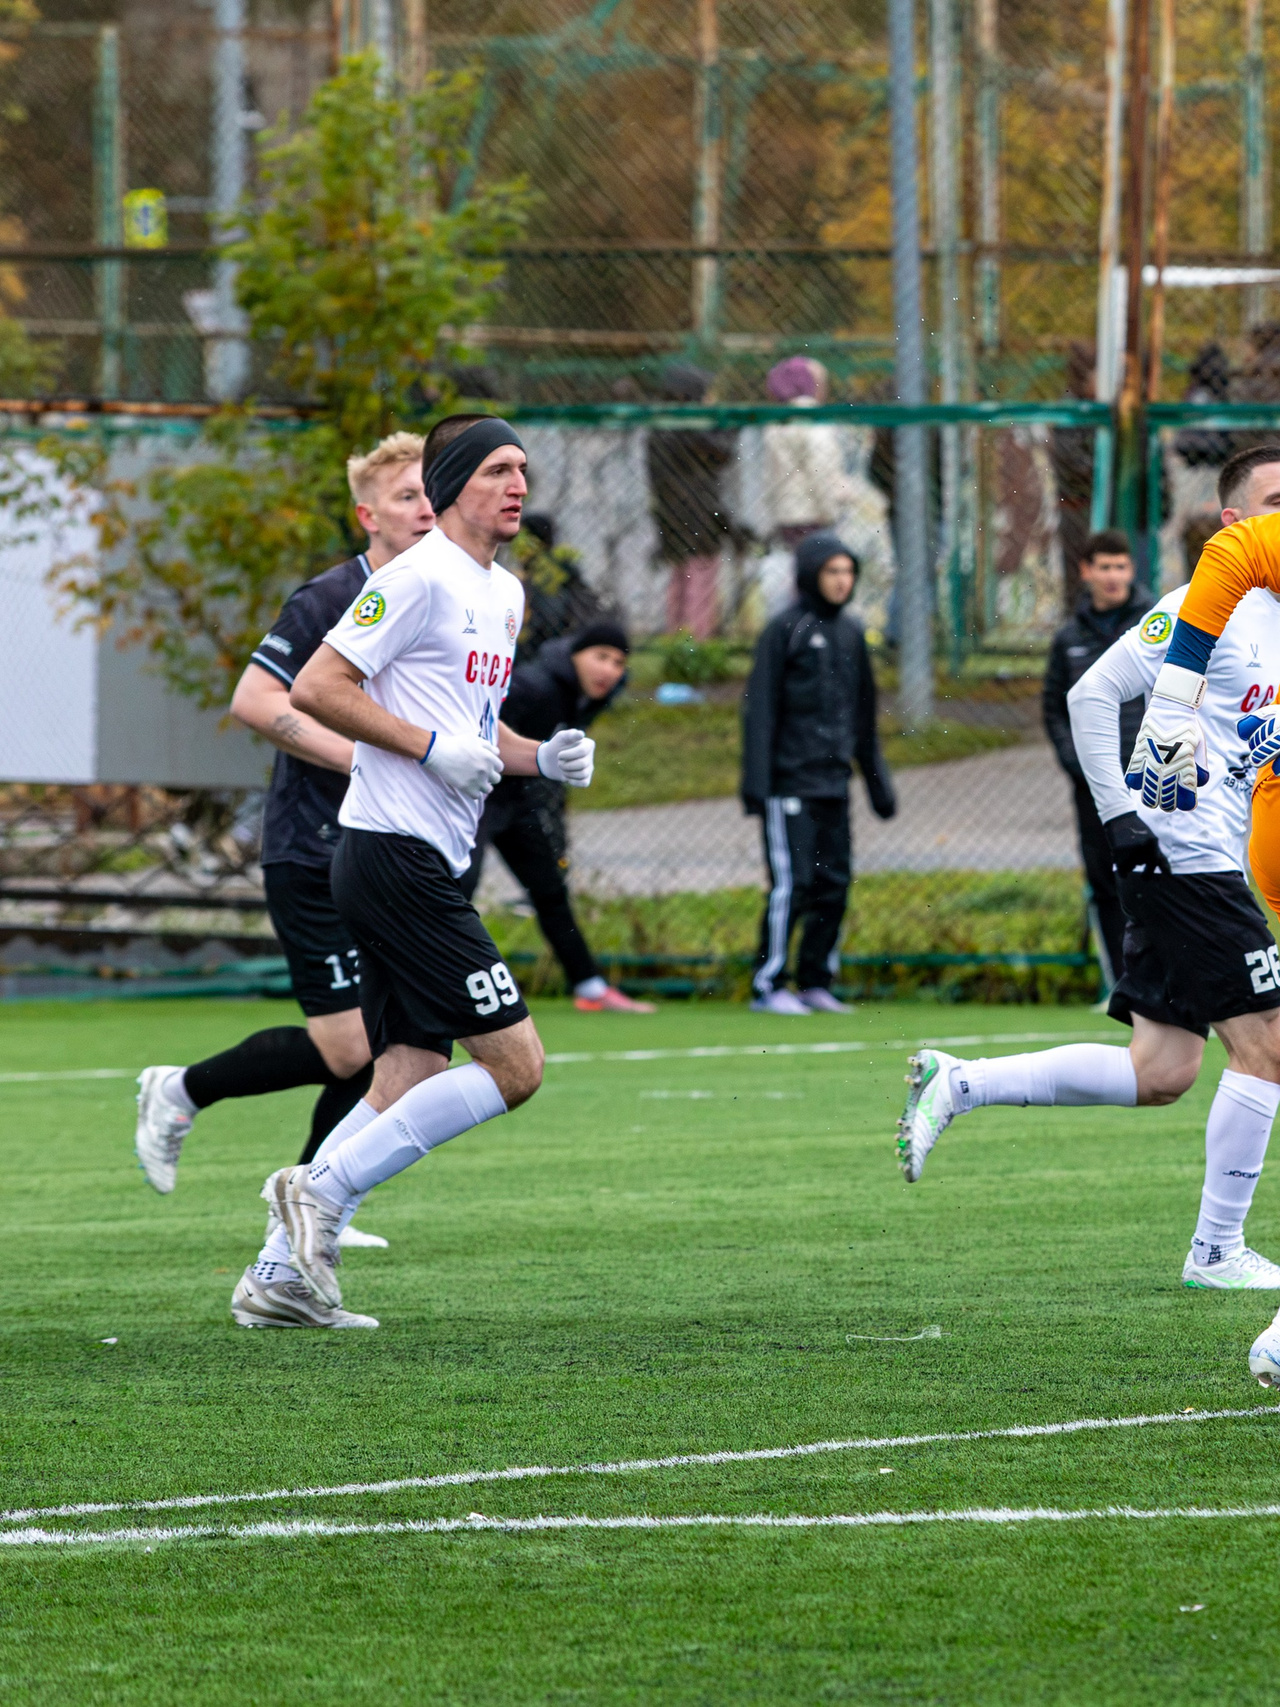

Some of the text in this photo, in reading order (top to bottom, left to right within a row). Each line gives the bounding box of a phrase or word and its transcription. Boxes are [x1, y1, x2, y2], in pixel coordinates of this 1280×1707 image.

[465, 650, 512, 688] СССР
[1240, 684, 1274, 713] СС
[465, 961, 519, 1016] 99
